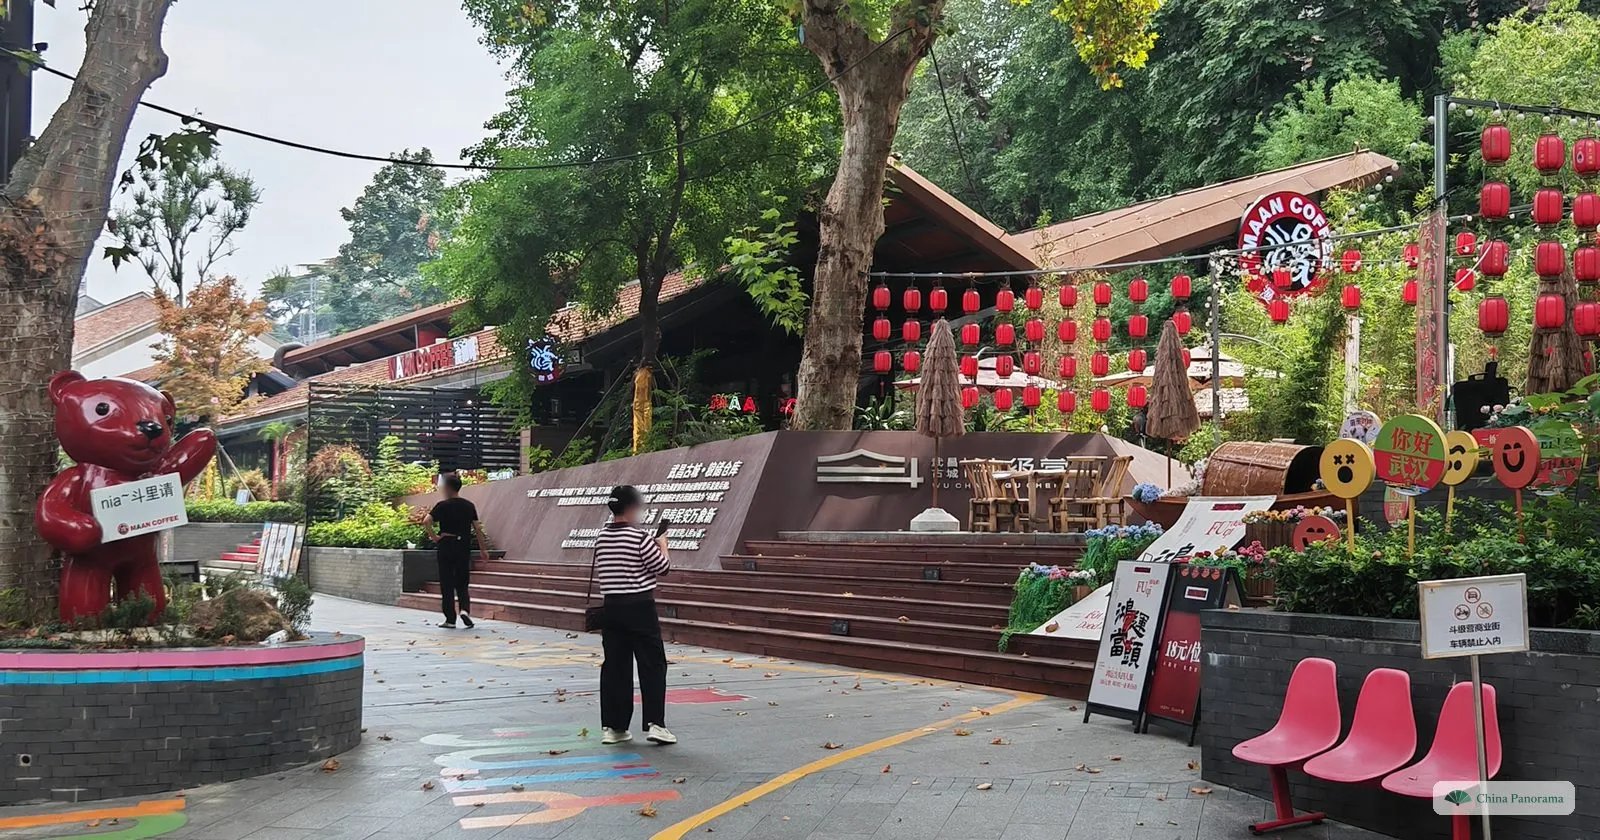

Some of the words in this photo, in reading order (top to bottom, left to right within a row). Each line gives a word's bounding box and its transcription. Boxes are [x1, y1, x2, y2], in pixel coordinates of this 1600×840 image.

[1242, 197, 1285, 254] MAAN
[1391, 427, 1433, 456] 你好
[1389, 455, 1430, 481] 武汉
[130, 521, 151, 532] MAAN
[152, 515, 179, 526] COFFEE
[1449, 621, 1501, 634] 斗级营商业街
[1165, 639, 1201, 663] 18元/位
[1449, 636, 1502, 649] 车辆禁止入内
